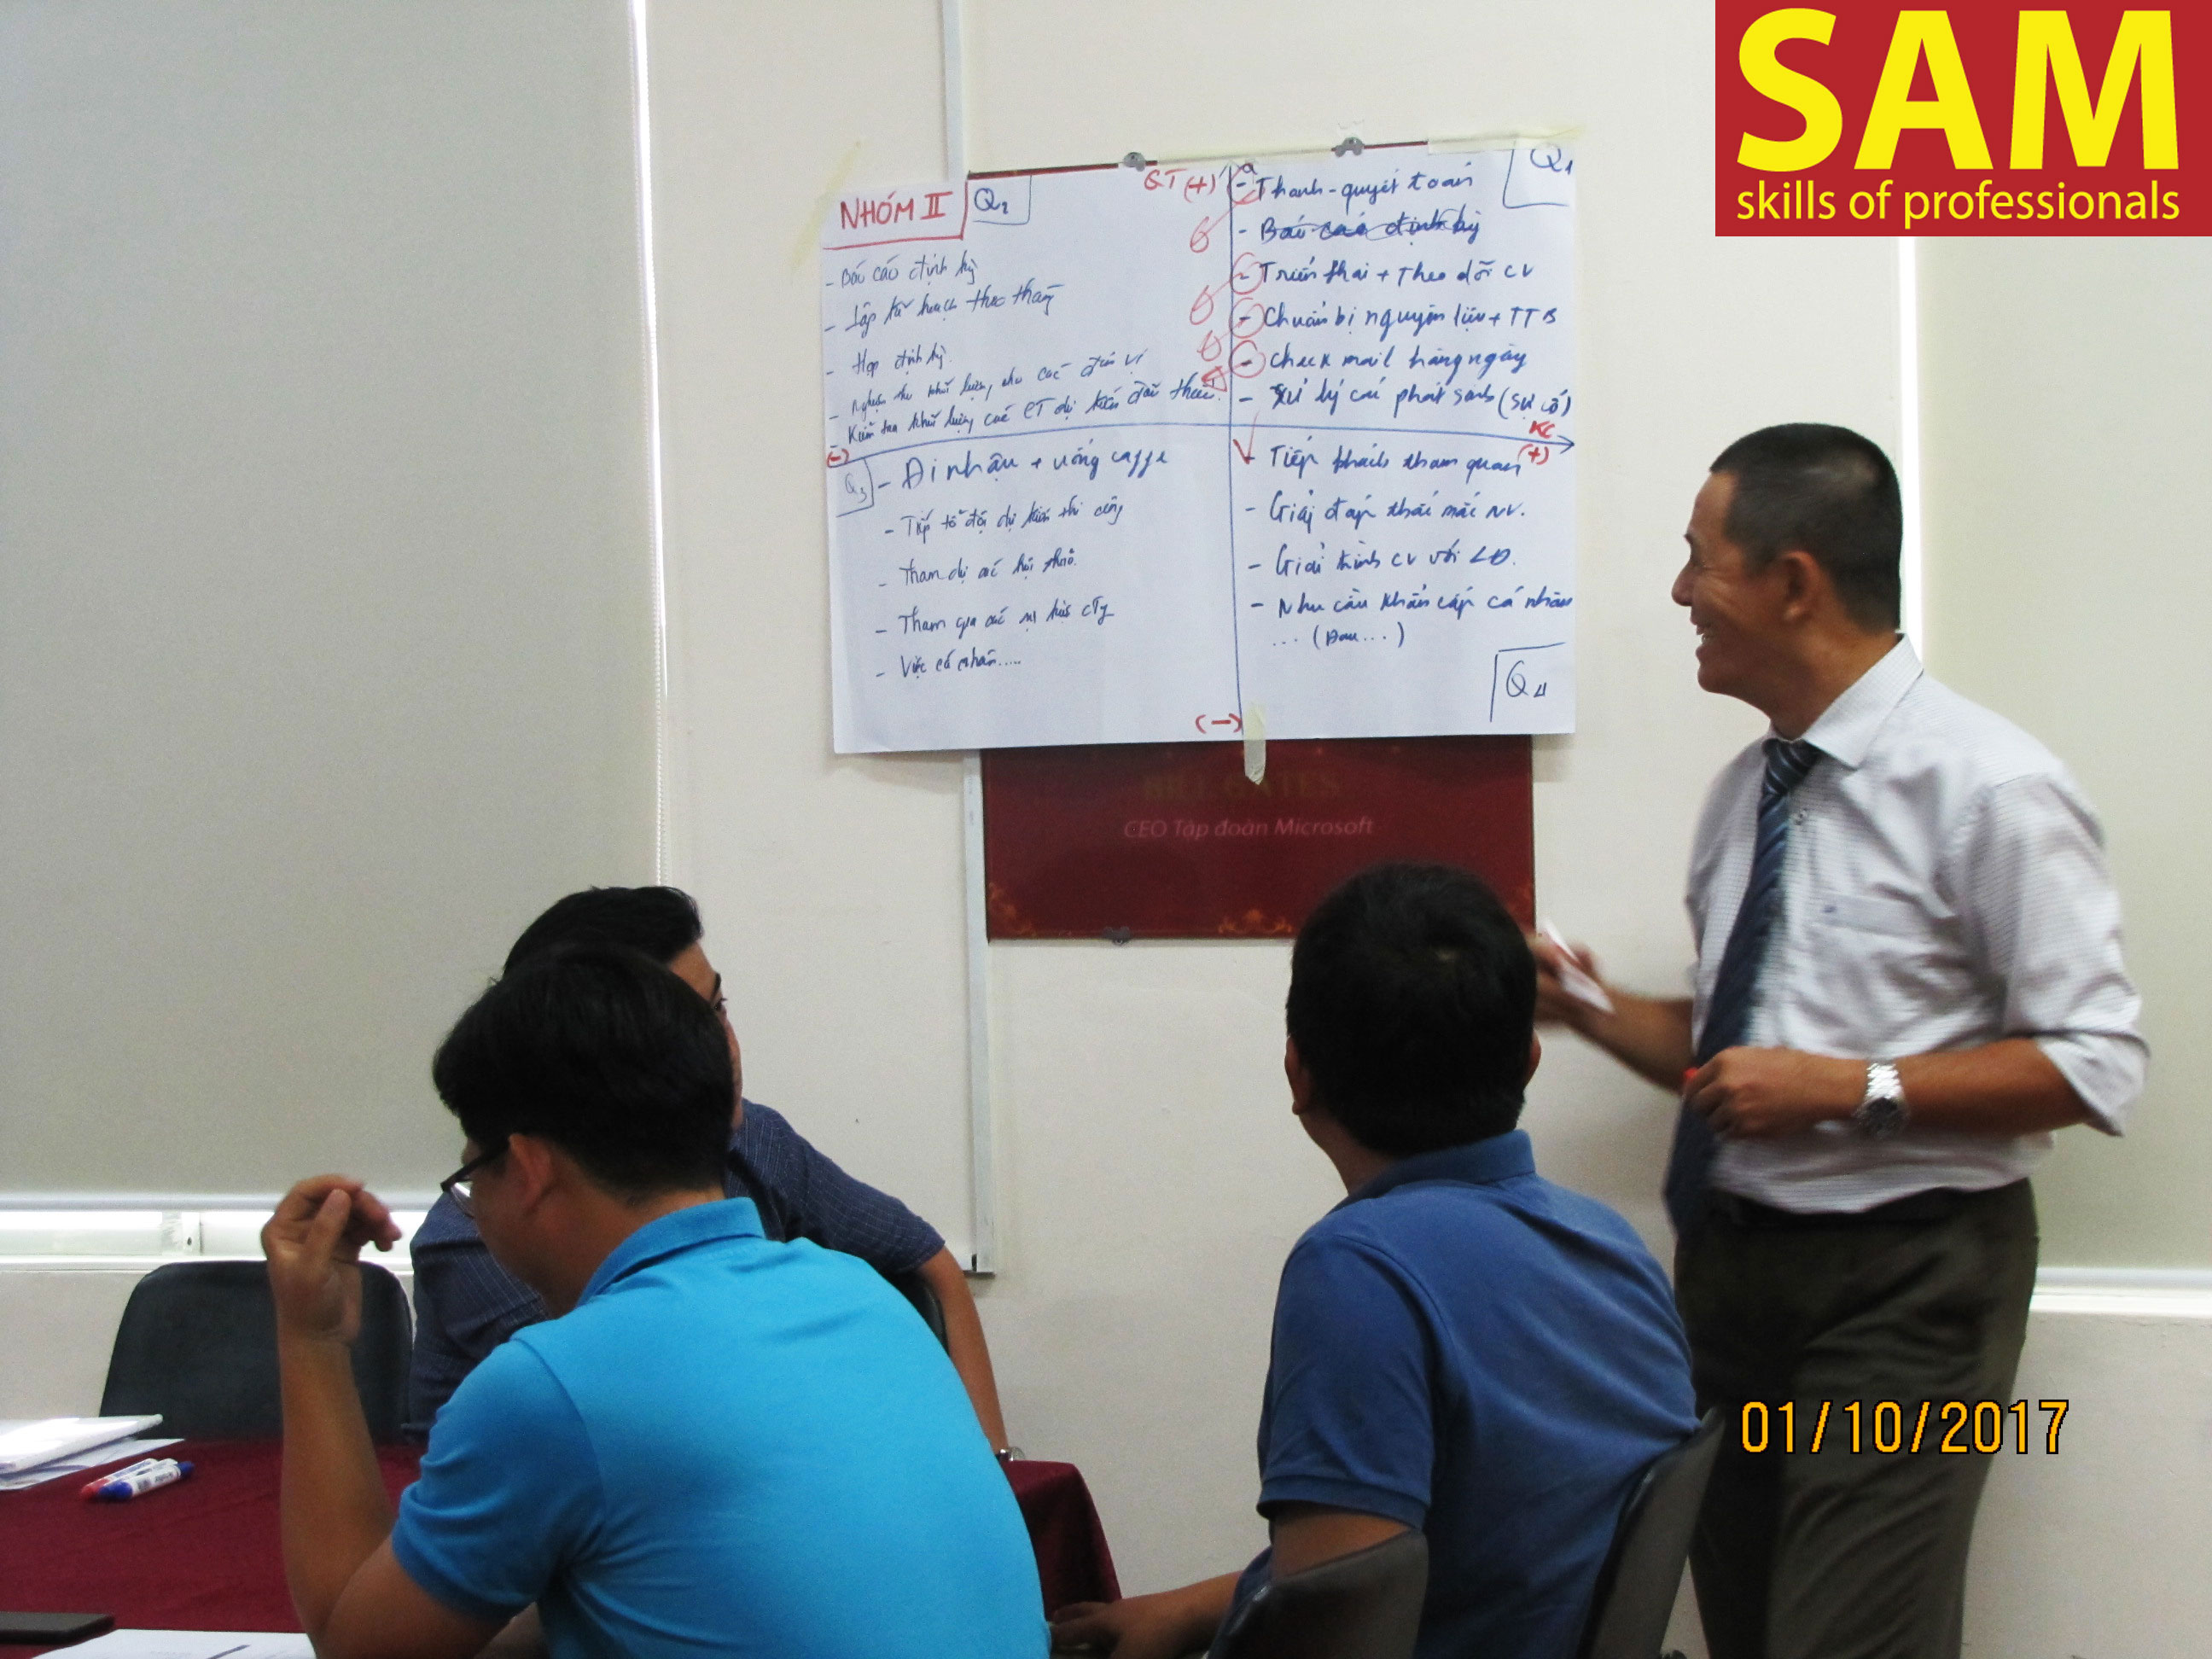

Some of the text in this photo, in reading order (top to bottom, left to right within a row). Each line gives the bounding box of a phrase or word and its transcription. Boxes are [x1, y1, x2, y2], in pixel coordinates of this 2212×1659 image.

[841, 191, 914, 230] NHÓM
[1124, 818, 1167, 839] CEO
[1214, 818, 1268, 837] đoàn
[1274, 816, 1374, 836] Microsoft
